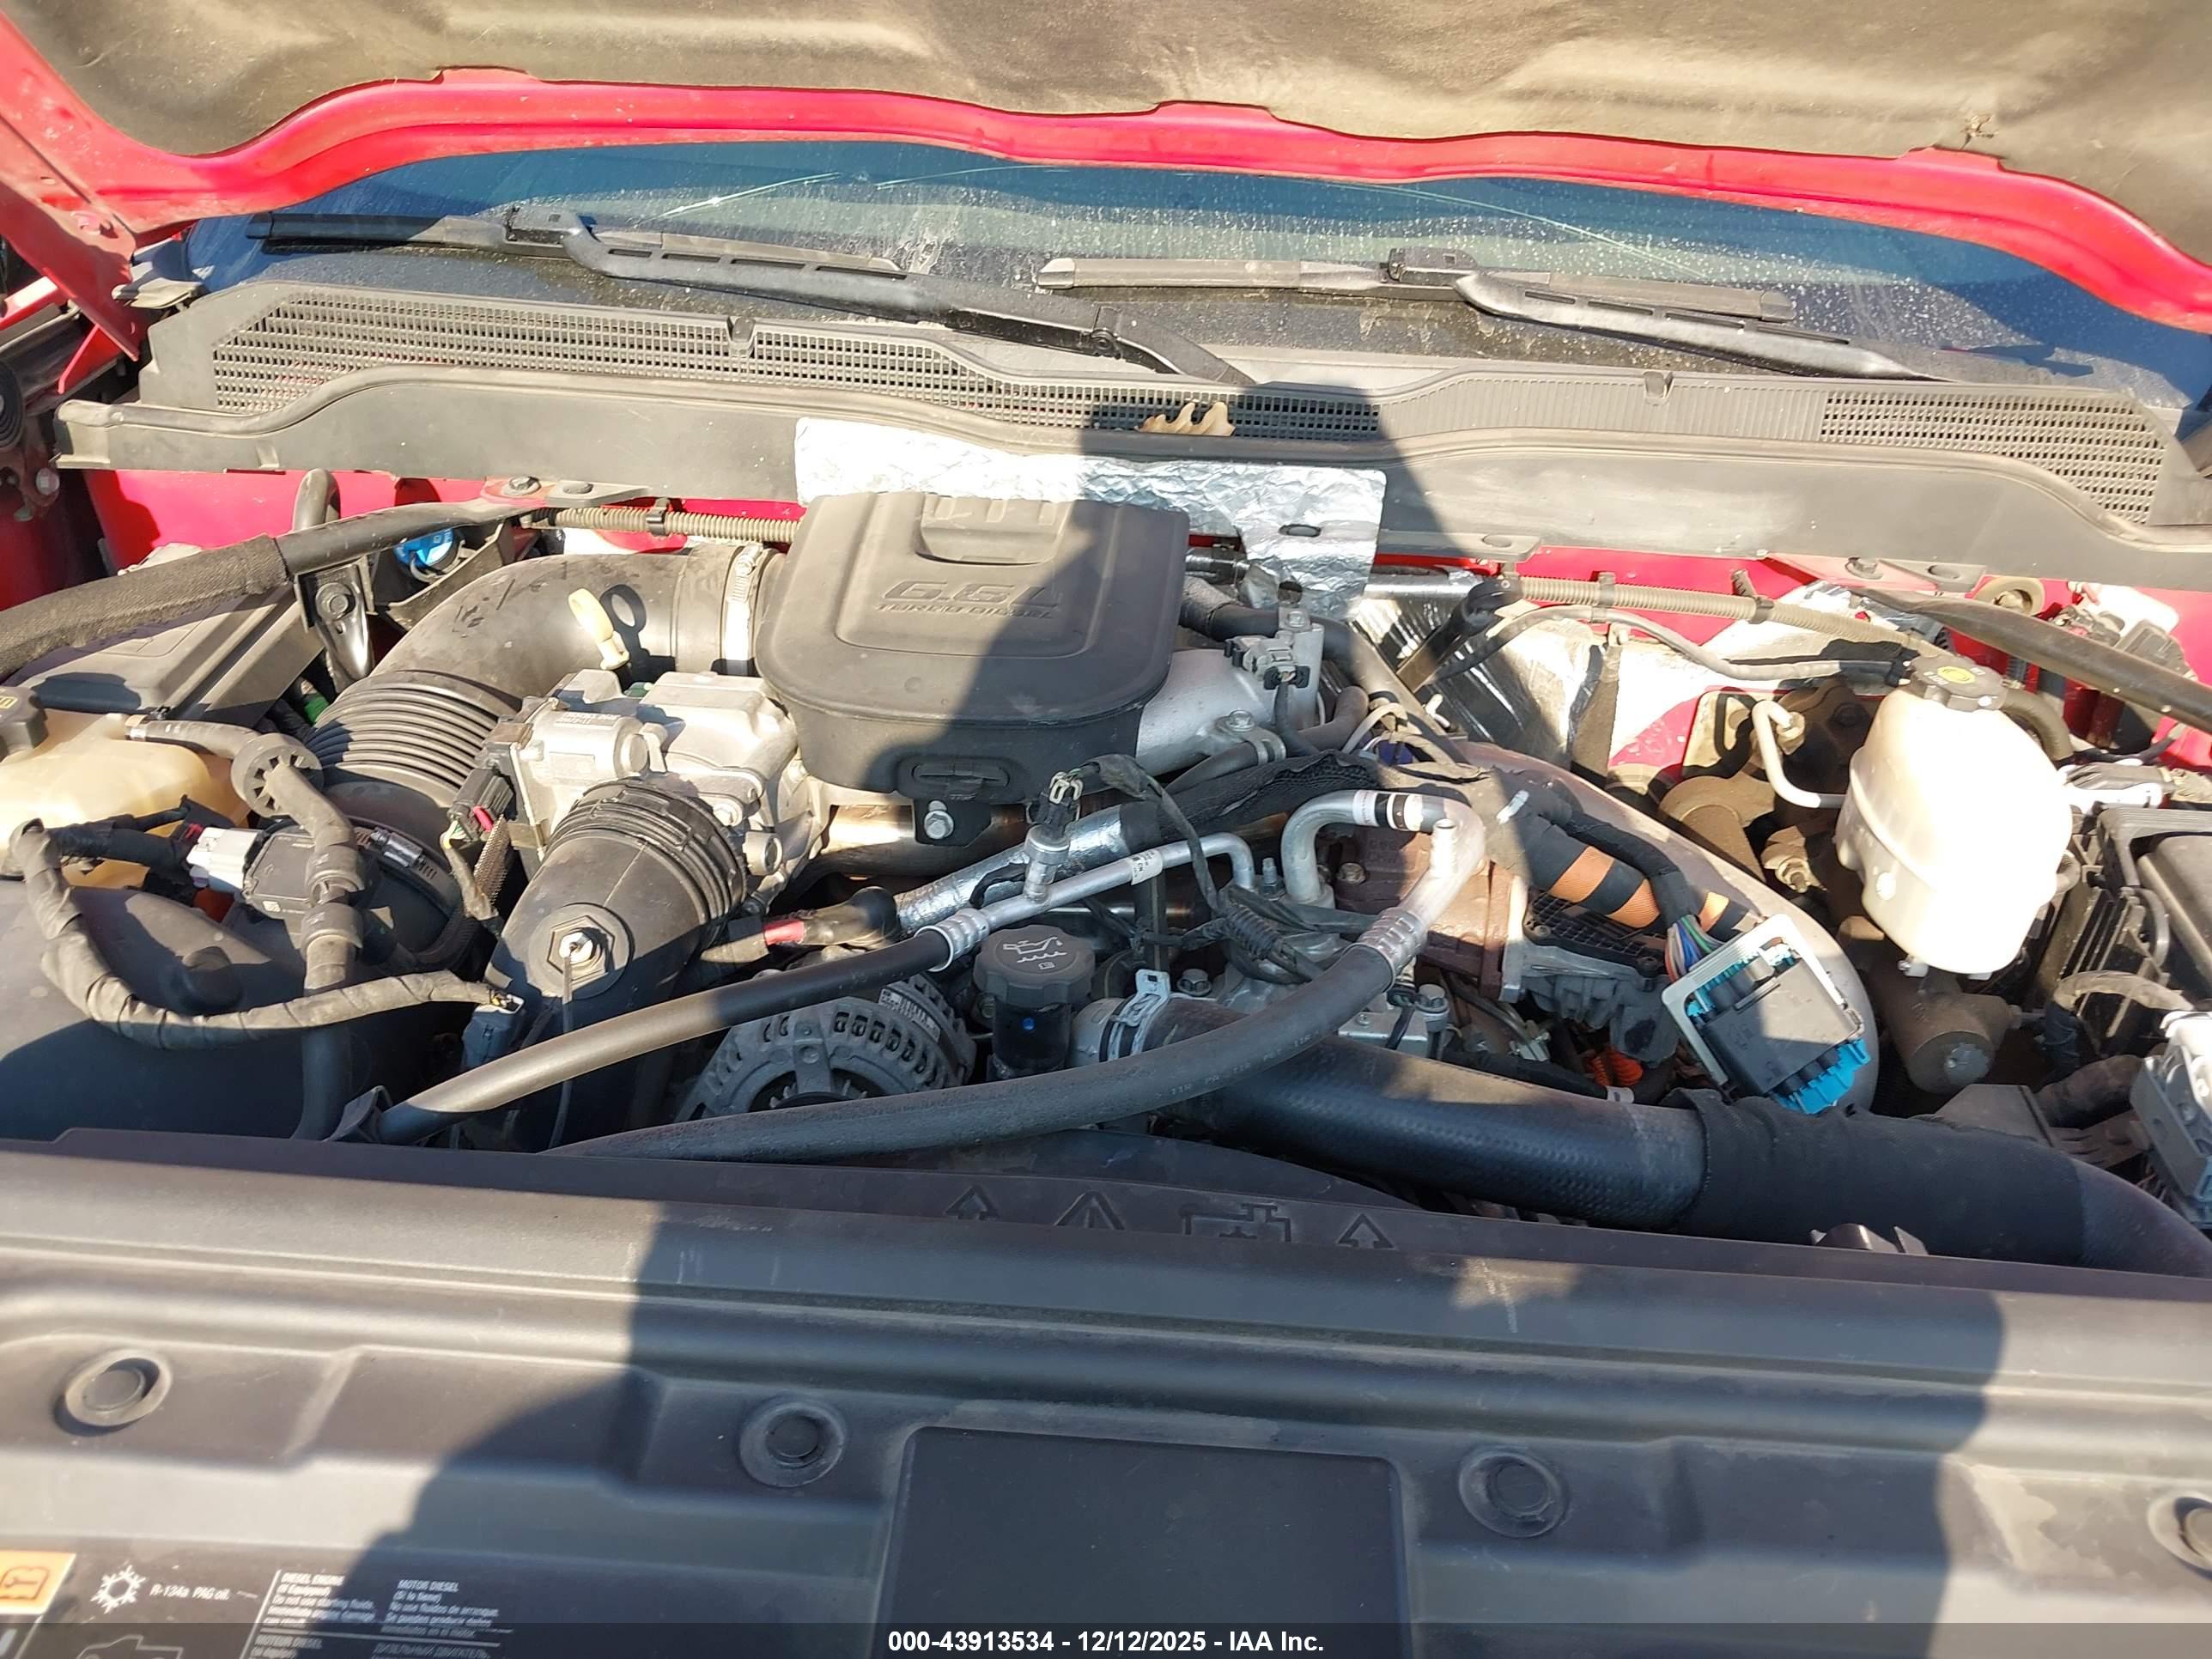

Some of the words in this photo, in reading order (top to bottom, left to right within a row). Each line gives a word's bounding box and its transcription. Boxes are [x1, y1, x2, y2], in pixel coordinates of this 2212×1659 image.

[884, 579, 1059, 610] 6.6L
[875, 604, 963, 614] TURBO
[281, 1572, 312, 1584] DIESEL
[311, 1574, 345, 1586] ENGINE
[397, 1579, 429, 1590] MOTOR
[428, 1581, 459, 1592] DIESEL
[149, 1583, 190, 1597] R-134a
[191, 1586, 216, 1599] PAG
